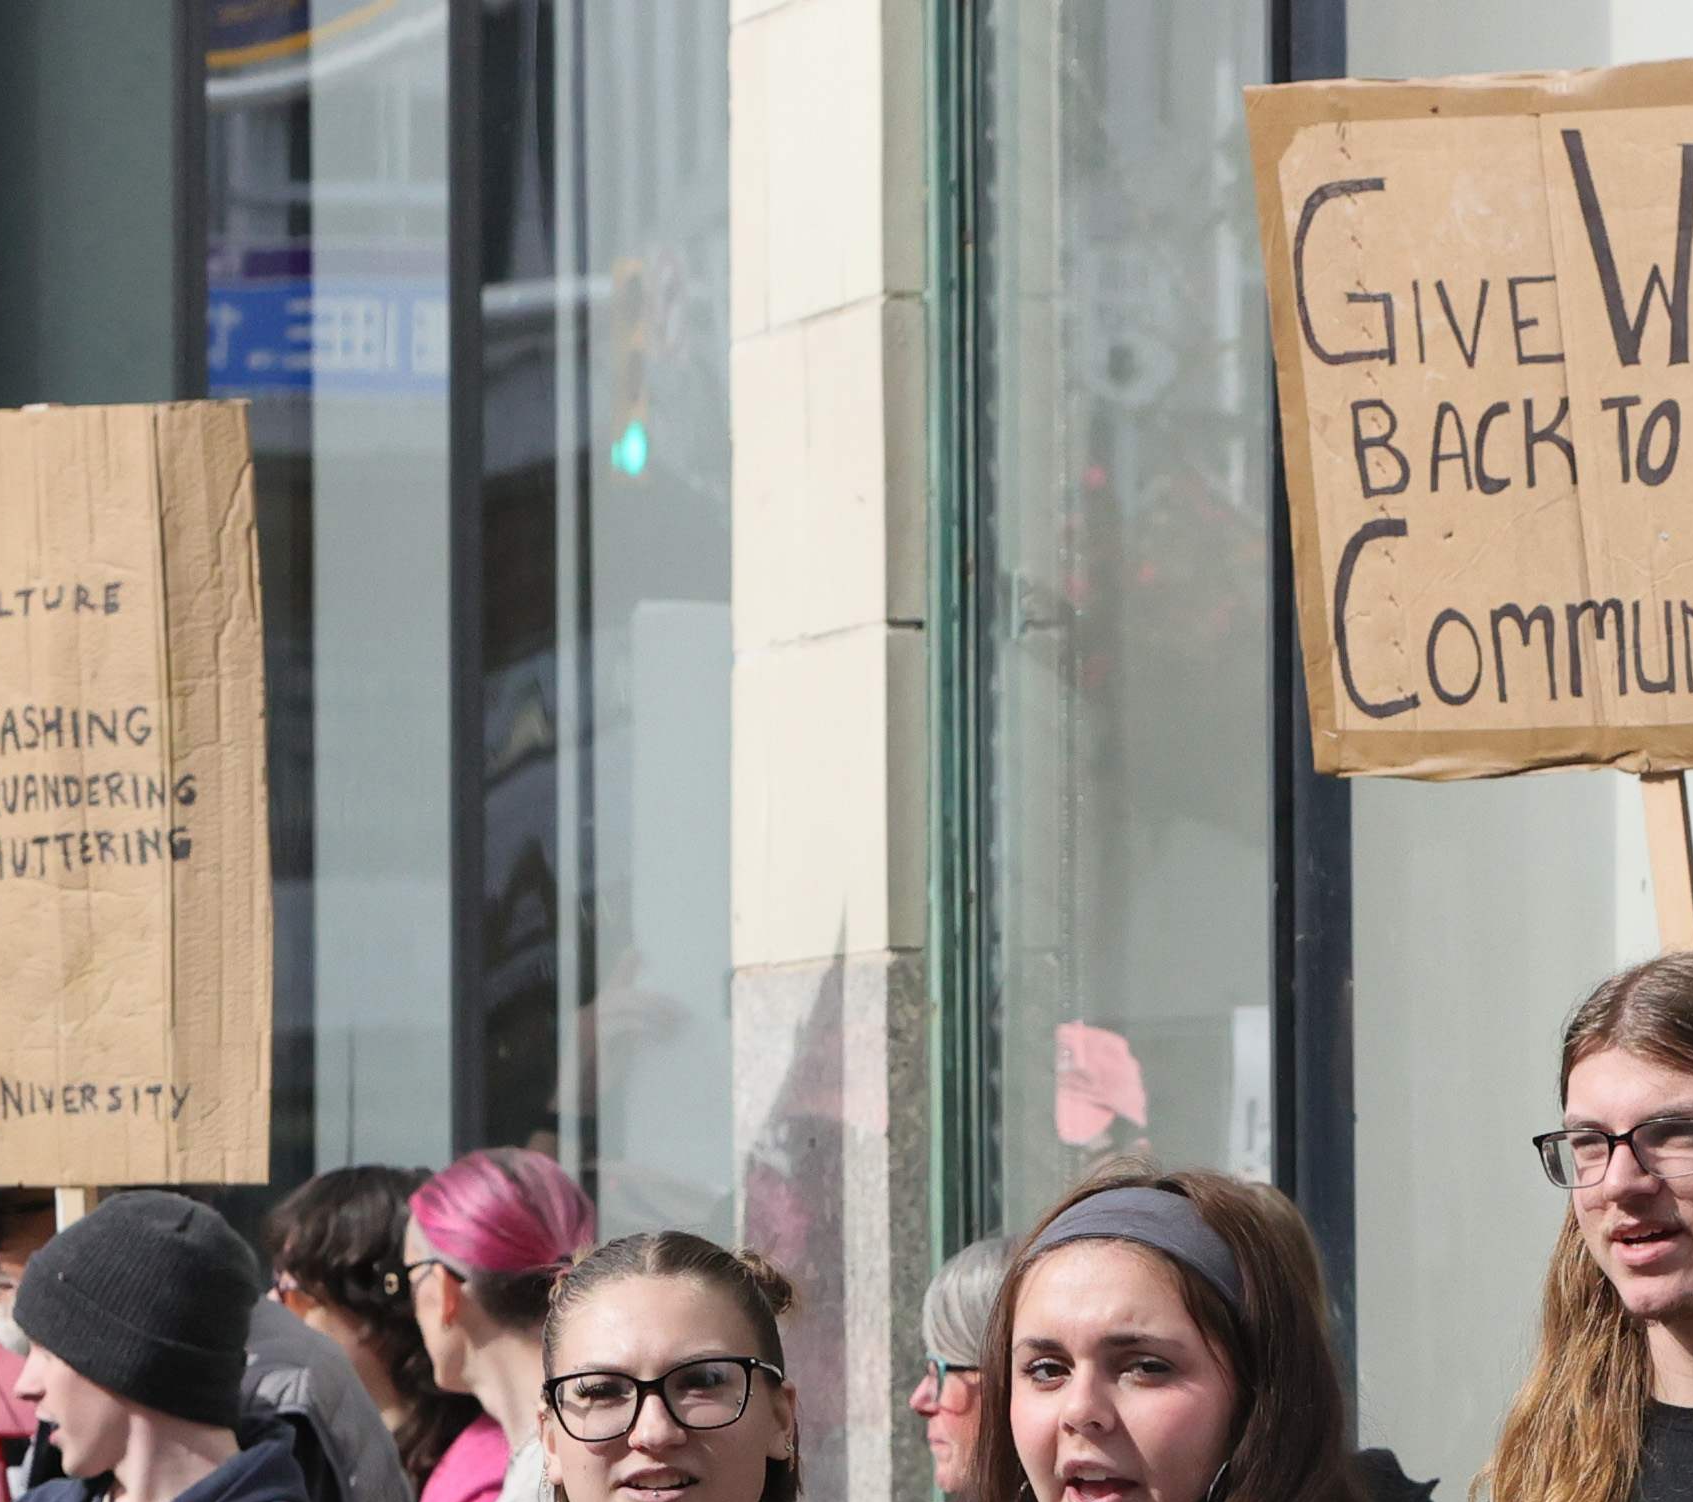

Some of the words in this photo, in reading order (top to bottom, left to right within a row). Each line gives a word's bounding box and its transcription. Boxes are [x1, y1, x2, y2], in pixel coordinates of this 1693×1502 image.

[1293, 176, 1566, 369] GIVE
[1350, 395, 1579, 499] BACK
[1601, 394, 1681, 487] TO
